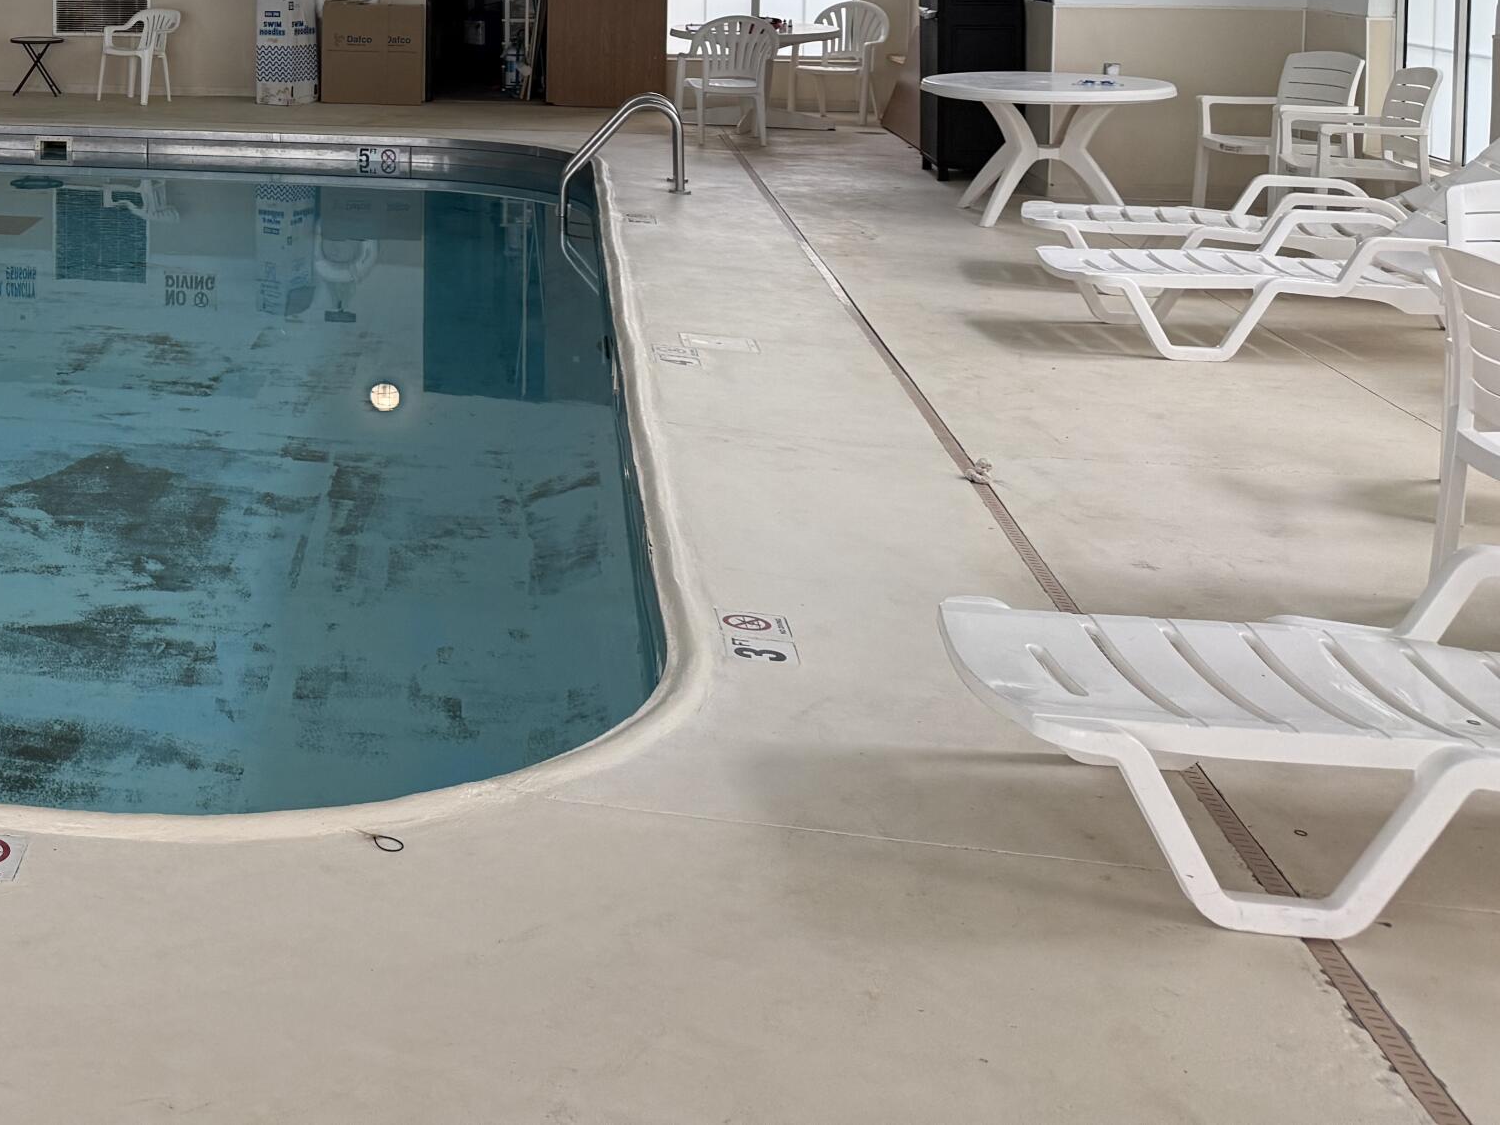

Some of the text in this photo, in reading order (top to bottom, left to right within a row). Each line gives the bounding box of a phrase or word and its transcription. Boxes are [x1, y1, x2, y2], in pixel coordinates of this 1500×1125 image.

[259, 28, 286, 36] noodles
[359, 148, 370, 162] 5
[733, 646, 788, 662] 3
